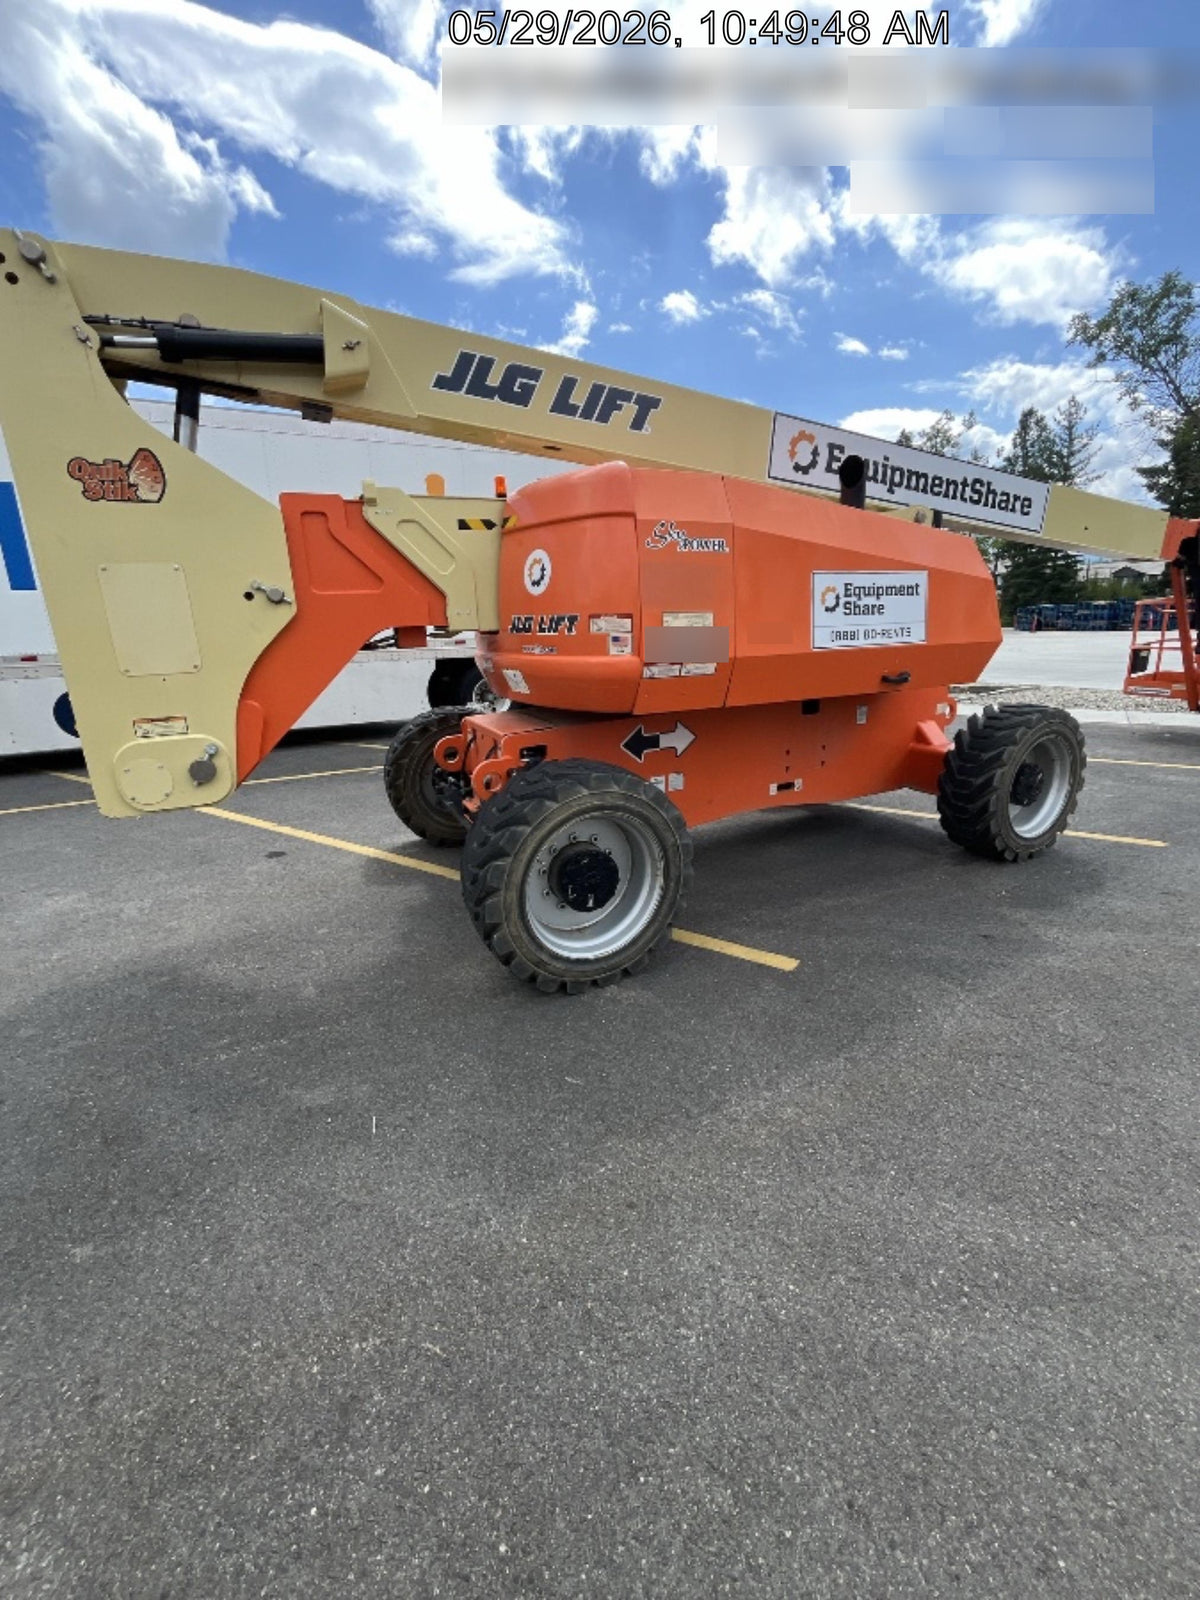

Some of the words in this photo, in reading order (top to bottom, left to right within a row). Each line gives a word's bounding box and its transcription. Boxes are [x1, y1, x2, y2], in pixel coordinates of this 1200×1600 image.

[430, 349, 545, 408] JLG
[547, 373, 663, 433] LIFT
[82, 479, 139, 501] Stik
[824, 442, 1032, 516] EuipmentShare
[843, 582, 920, 601] Equipment
[843, 600, 885, 616] Share
[508, 615, 536, 635] JLG
[536, 613, 579, 636] LIFT
